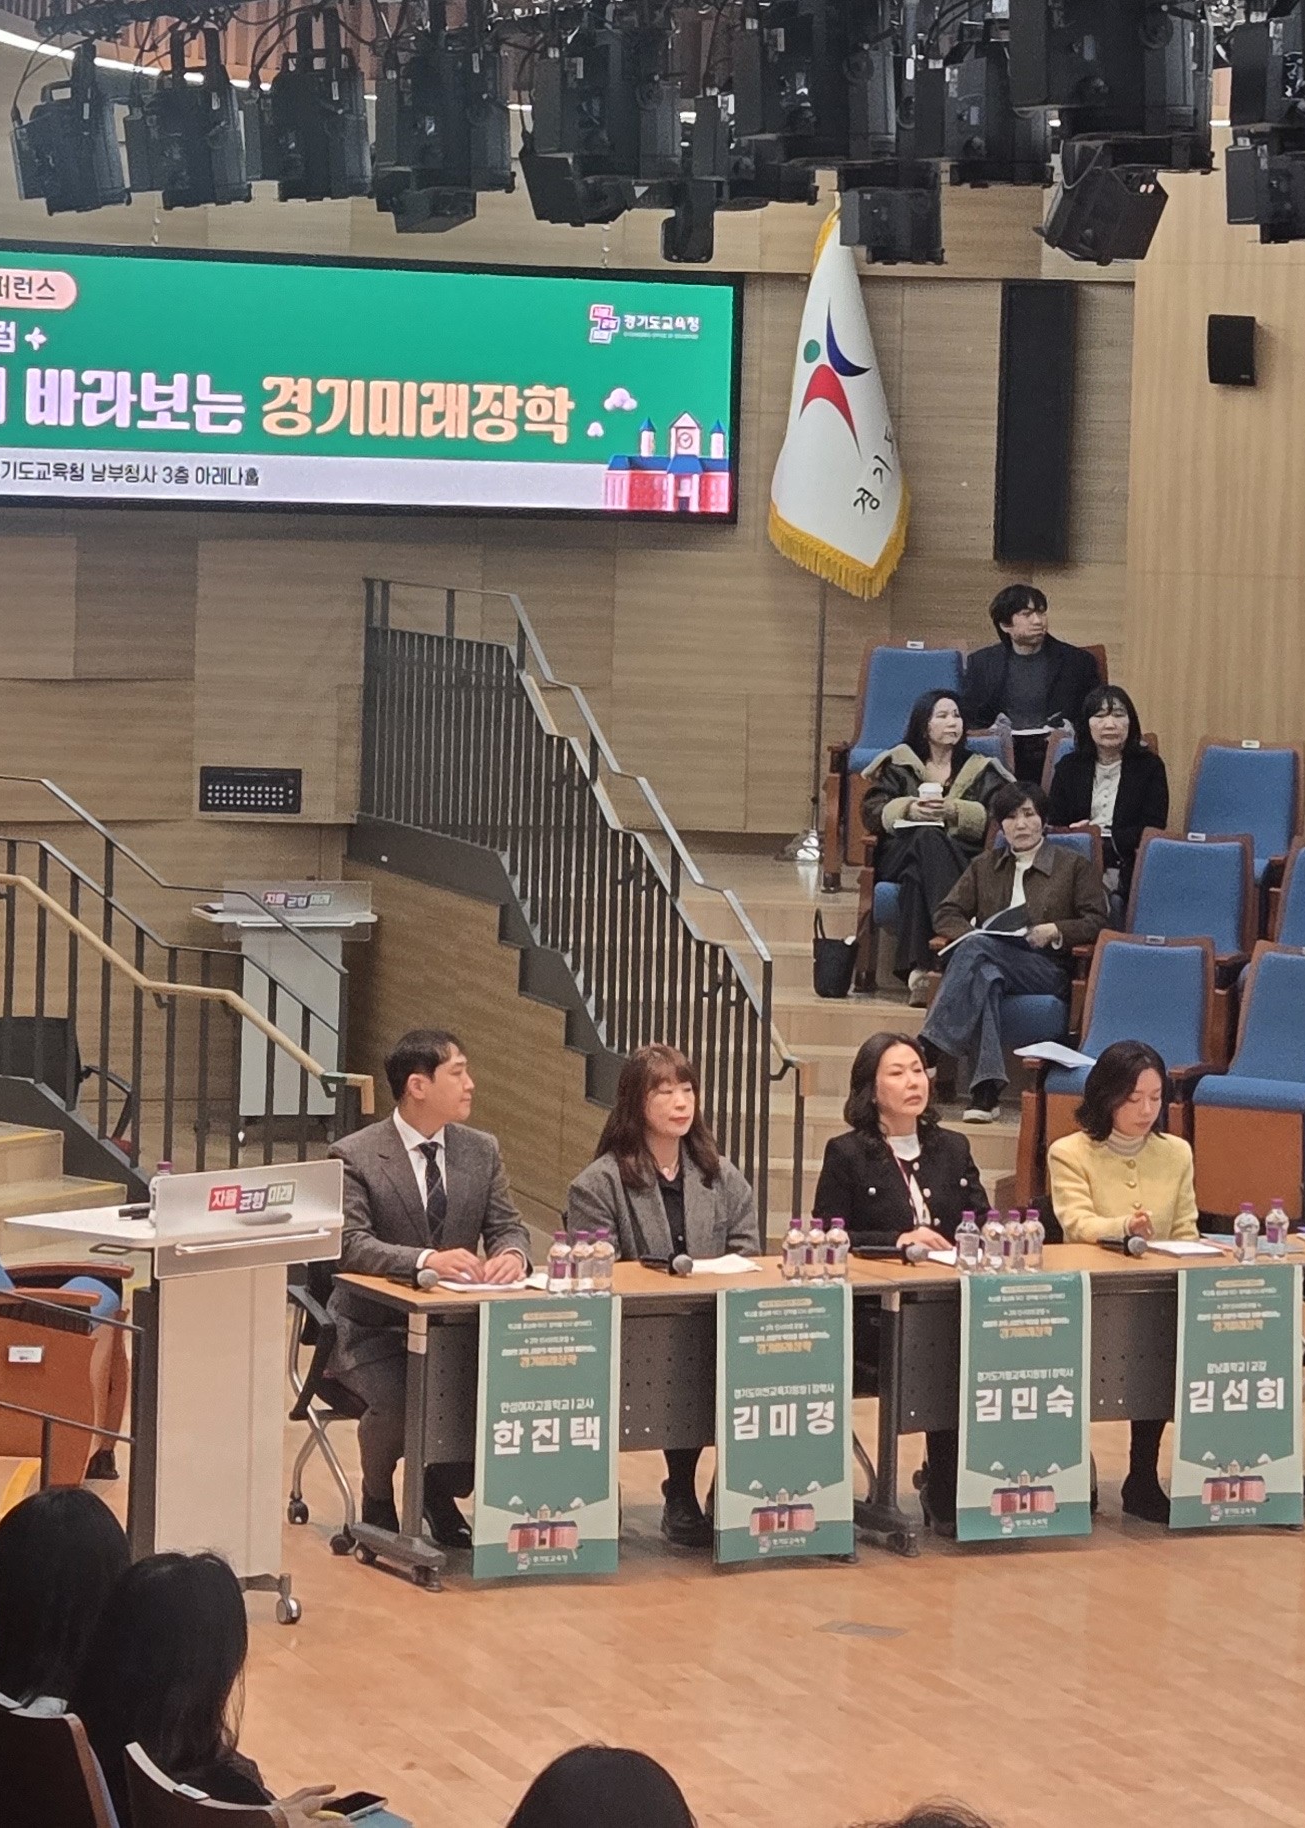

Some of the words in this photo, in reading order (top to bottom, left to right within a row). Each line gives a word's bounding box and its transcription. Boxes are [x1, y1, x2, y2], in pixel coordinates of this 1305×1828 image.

[624, 314, 700, 333] 경기도교육청
[24, 367, 246, 434] 바라보는
[261, 375, 575, 445] 경기미래장학
[92, 464, 157, 485] 남부청사
[162, 466, 190, 485] 3층
[195, 466, 259, 487] 아레나홀
[211, 1187, 238, 1207] 자율
[239, 1191, 265, 1211] 균형
[268, 1184, 293, 1204] 미래
[976, 1385, 1074, 1422] 김민숙
[1189, 1378, 1284, 1413] 김선희
[493, 1416, 601, 1455] 한진택
[733, 1400, 835, 1440] 김미경
